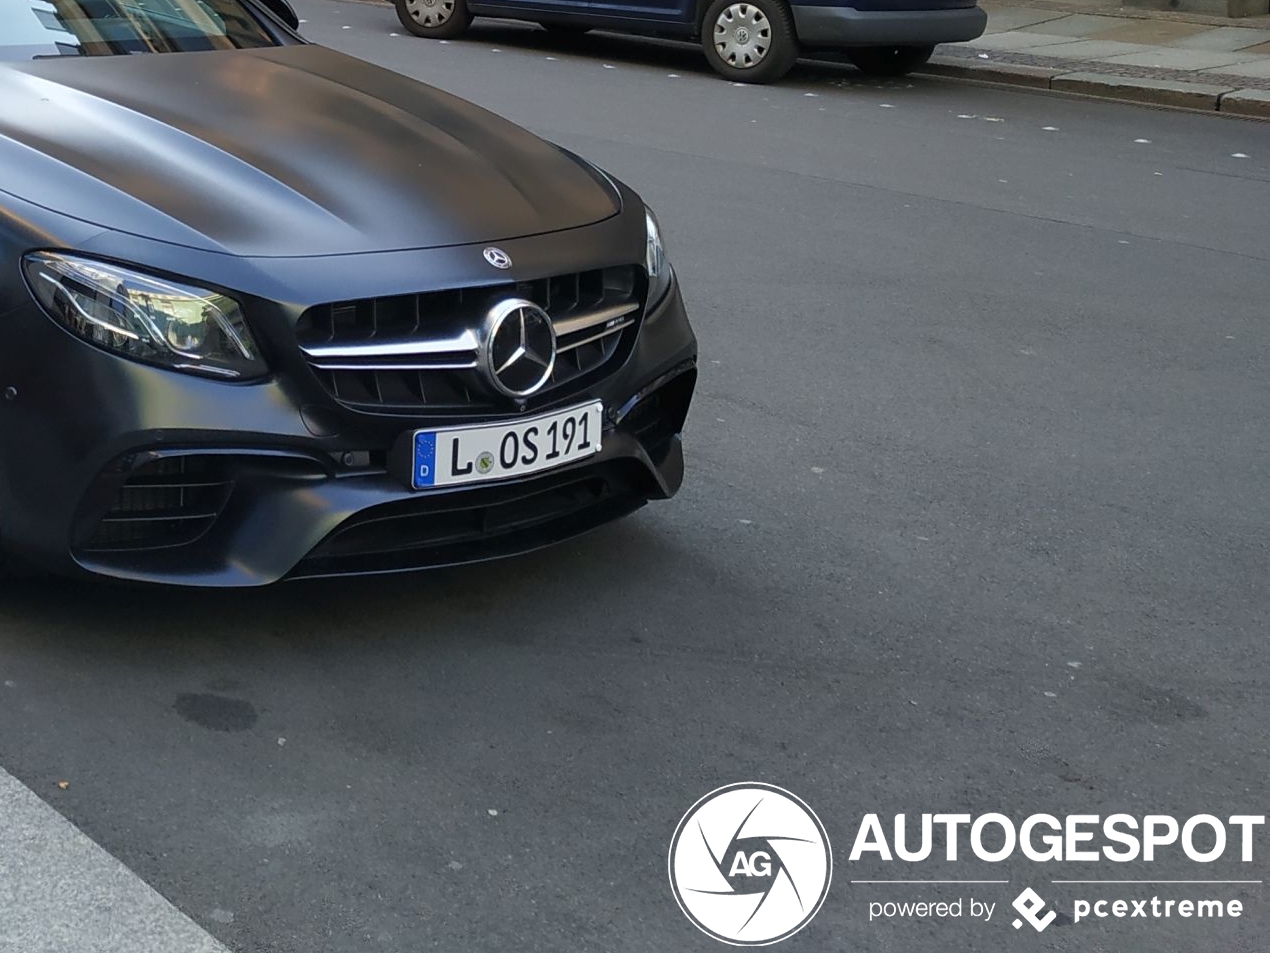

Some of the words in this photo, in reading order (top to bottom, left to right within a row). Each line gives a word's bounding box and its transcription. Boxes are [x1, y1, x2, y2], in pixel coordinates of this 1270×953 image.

[451, 438, 472, 476] L
[545, 411, 591, 460] 191
[420, 464, 429, 477] D
